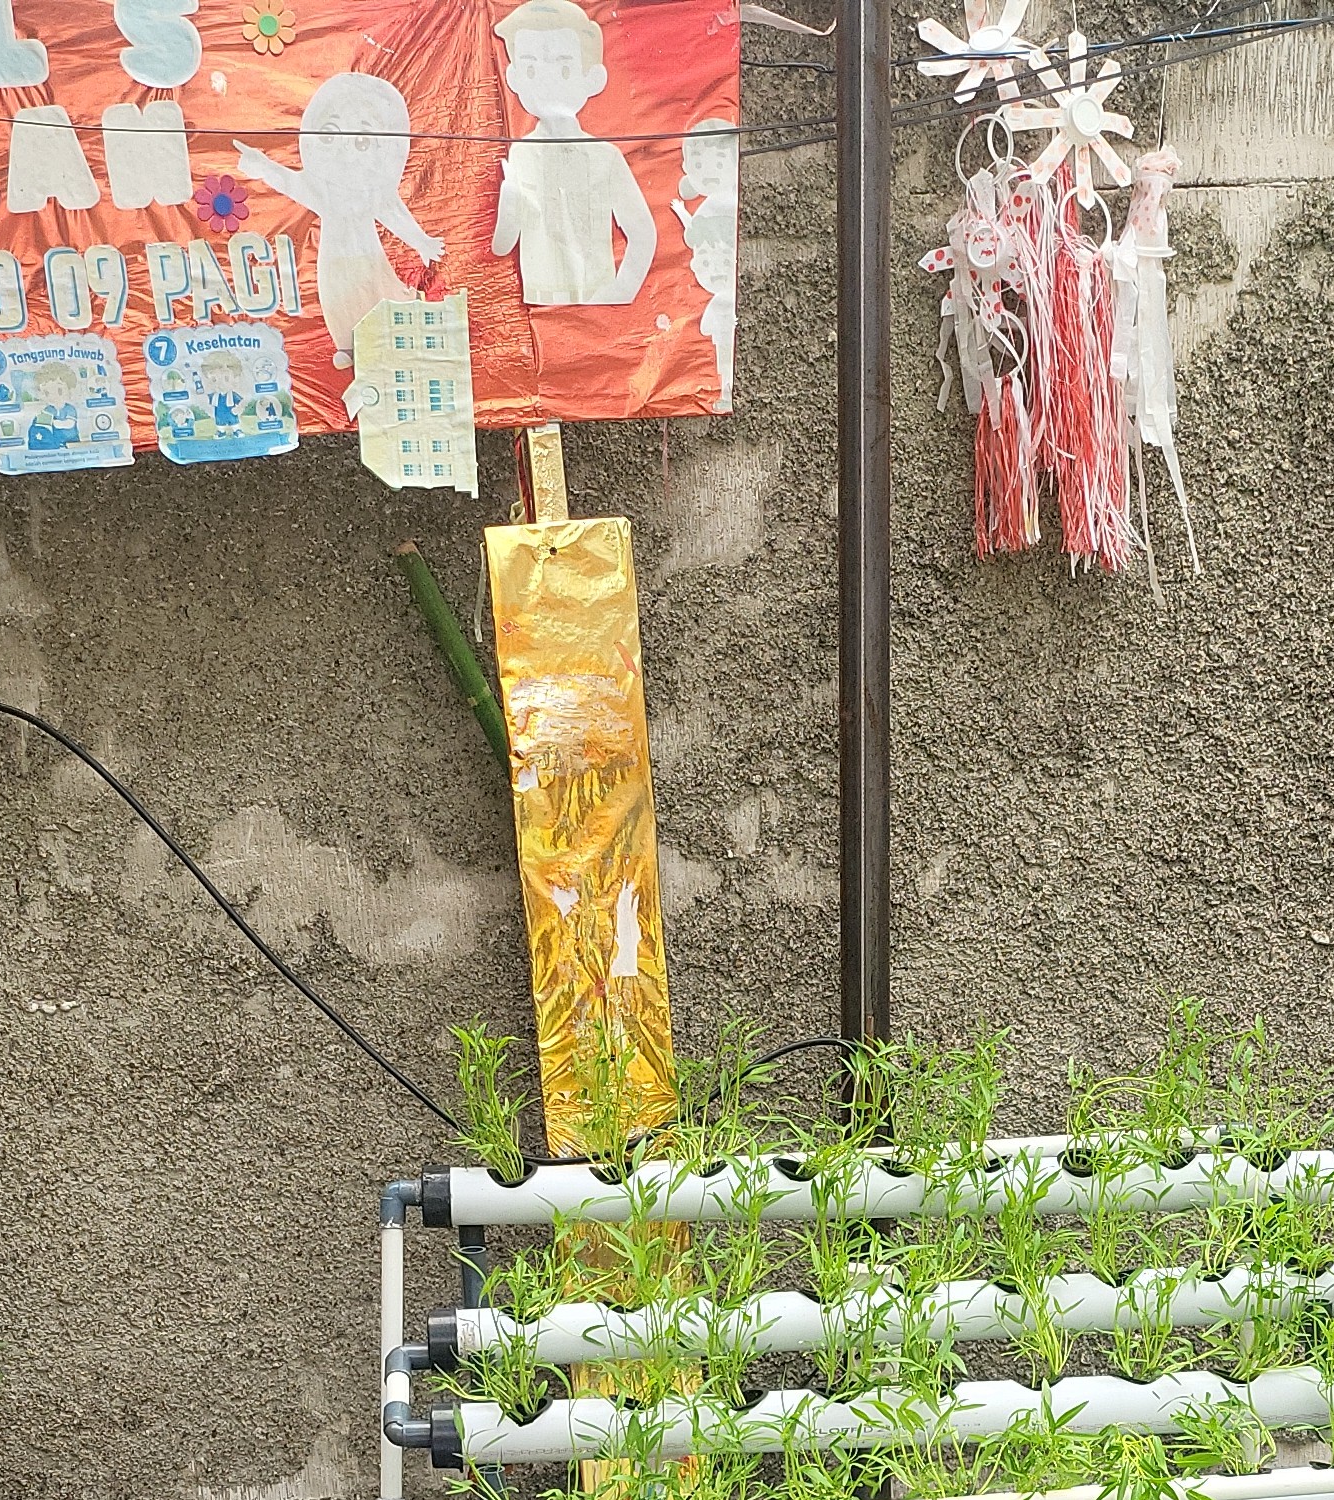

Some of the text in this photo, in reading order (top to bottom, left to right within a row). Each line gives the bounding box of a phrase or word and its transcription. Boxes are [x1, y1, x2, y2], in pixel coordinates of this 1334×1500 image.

[43, 245, 129, 331] 09
[146, 232, 302, 322] PAGI
[155, 341, 168, 362] 7
[185, 334, 261, 355] Kesehatan
[8, 346, 105, 366] Tanggung Jawab
